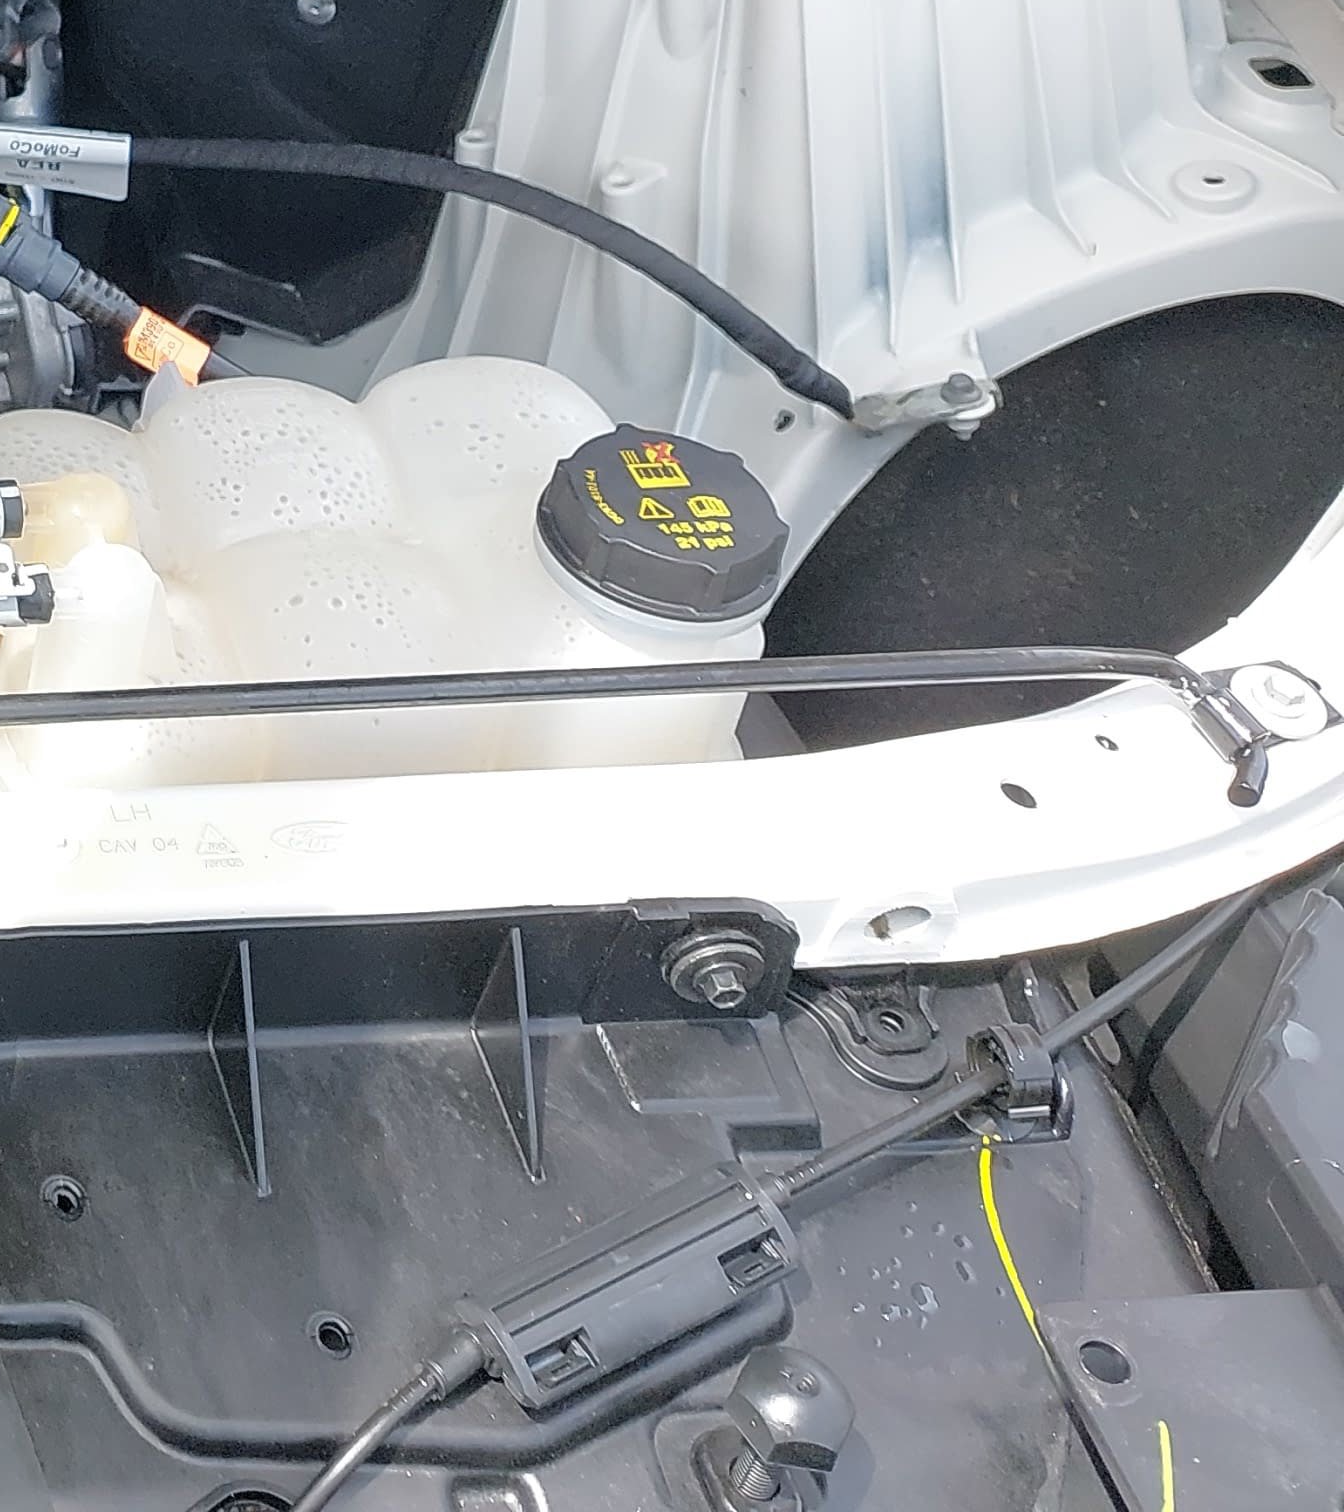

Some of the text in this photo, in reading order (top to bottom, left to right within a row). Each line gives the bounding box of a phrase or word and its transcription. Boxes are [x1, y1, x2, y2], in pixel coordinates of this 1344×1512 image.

[10, 140, 81, 158] FoMoCo
[658, 520, 734, 535] 145 kPa
[675, 535, 735, 551] 21 psi
[110, 804, 152, 822] LH
[99, 838, 138, 855] CAV
[153, 837, 180, 853] 04
